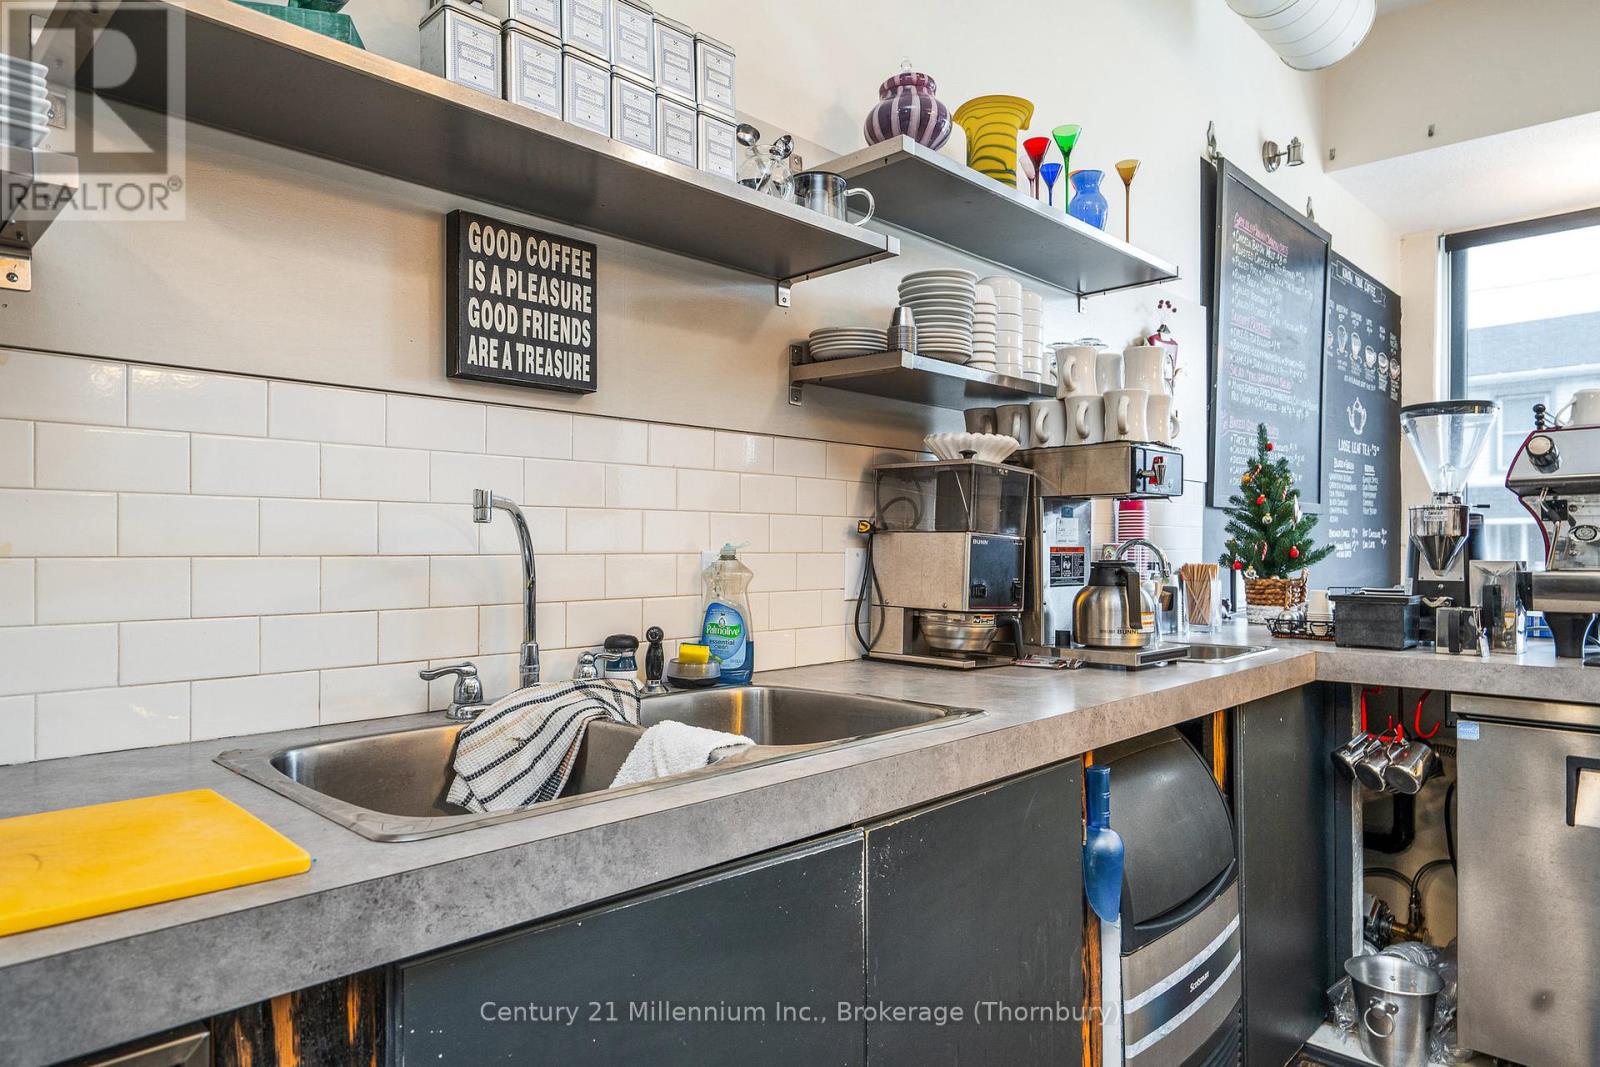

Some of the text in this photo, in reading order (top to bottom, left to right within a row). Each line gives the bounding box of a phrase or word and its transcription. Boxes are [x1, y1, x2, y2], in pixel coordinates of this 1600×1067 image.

[468, 220, 592, 280] GOOD COFFEE
[467, 259, 592, 314] IS A PLEASURE
[467, 296, 592, 348] GOOD FRIENDS
[466, 334, 592, 382] ARE A TREASURE
[706, 624, 741, 636] Palmolive
